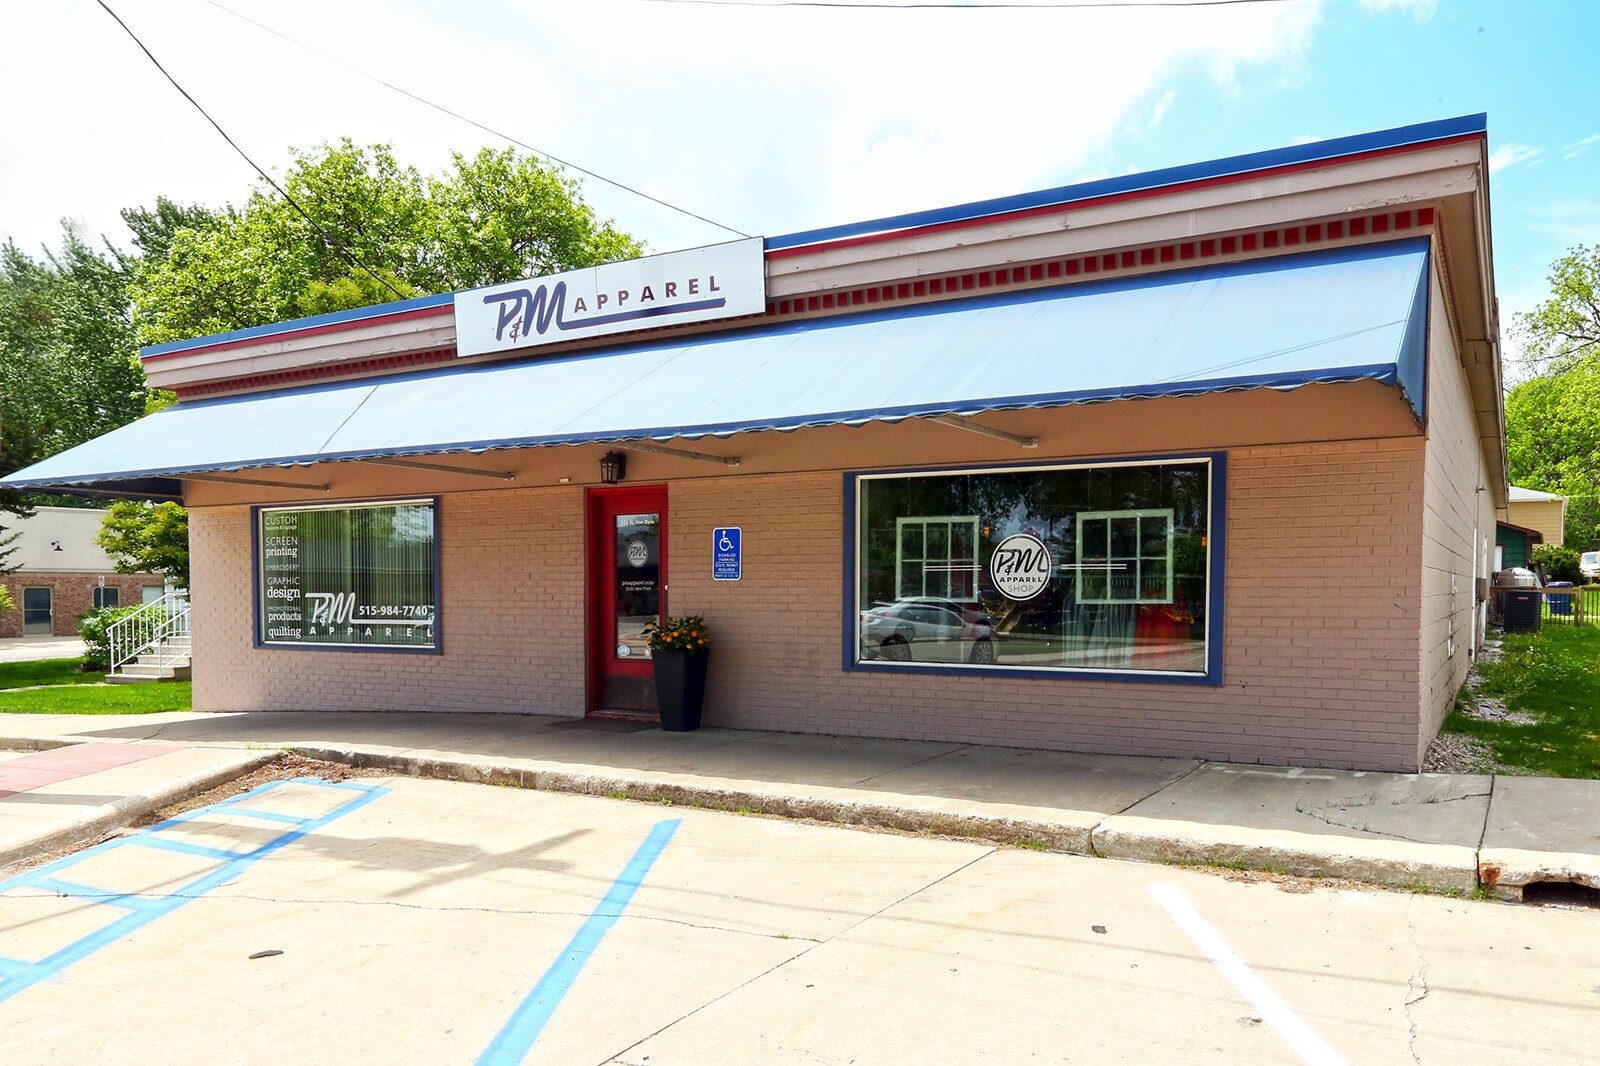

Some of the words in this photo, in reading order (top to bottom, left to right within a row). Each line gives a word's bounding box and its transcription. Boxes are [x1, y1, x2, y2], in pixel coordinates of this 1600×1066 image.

[483, 281, 567, 343] P&M
[574, 275, 721, 313] APPAREL
[265, 515, 298, 525] CUSTOM
[265, 536, 298, 546] SCREEN
[265, 546, 298, 558] printing
[996, 548, 1047, 576] P&M
[267, 576, 300, 585] GRAPHIC
[267, 586, 301, 601] design
[305, 592, 356, 626] P&M
[359, 605, 428, 616] 515-984-7740
[268, 612, 302, 623] products
[268, 626, 302, 639] quilting
[309, 626, 433, 637] APPAREL
